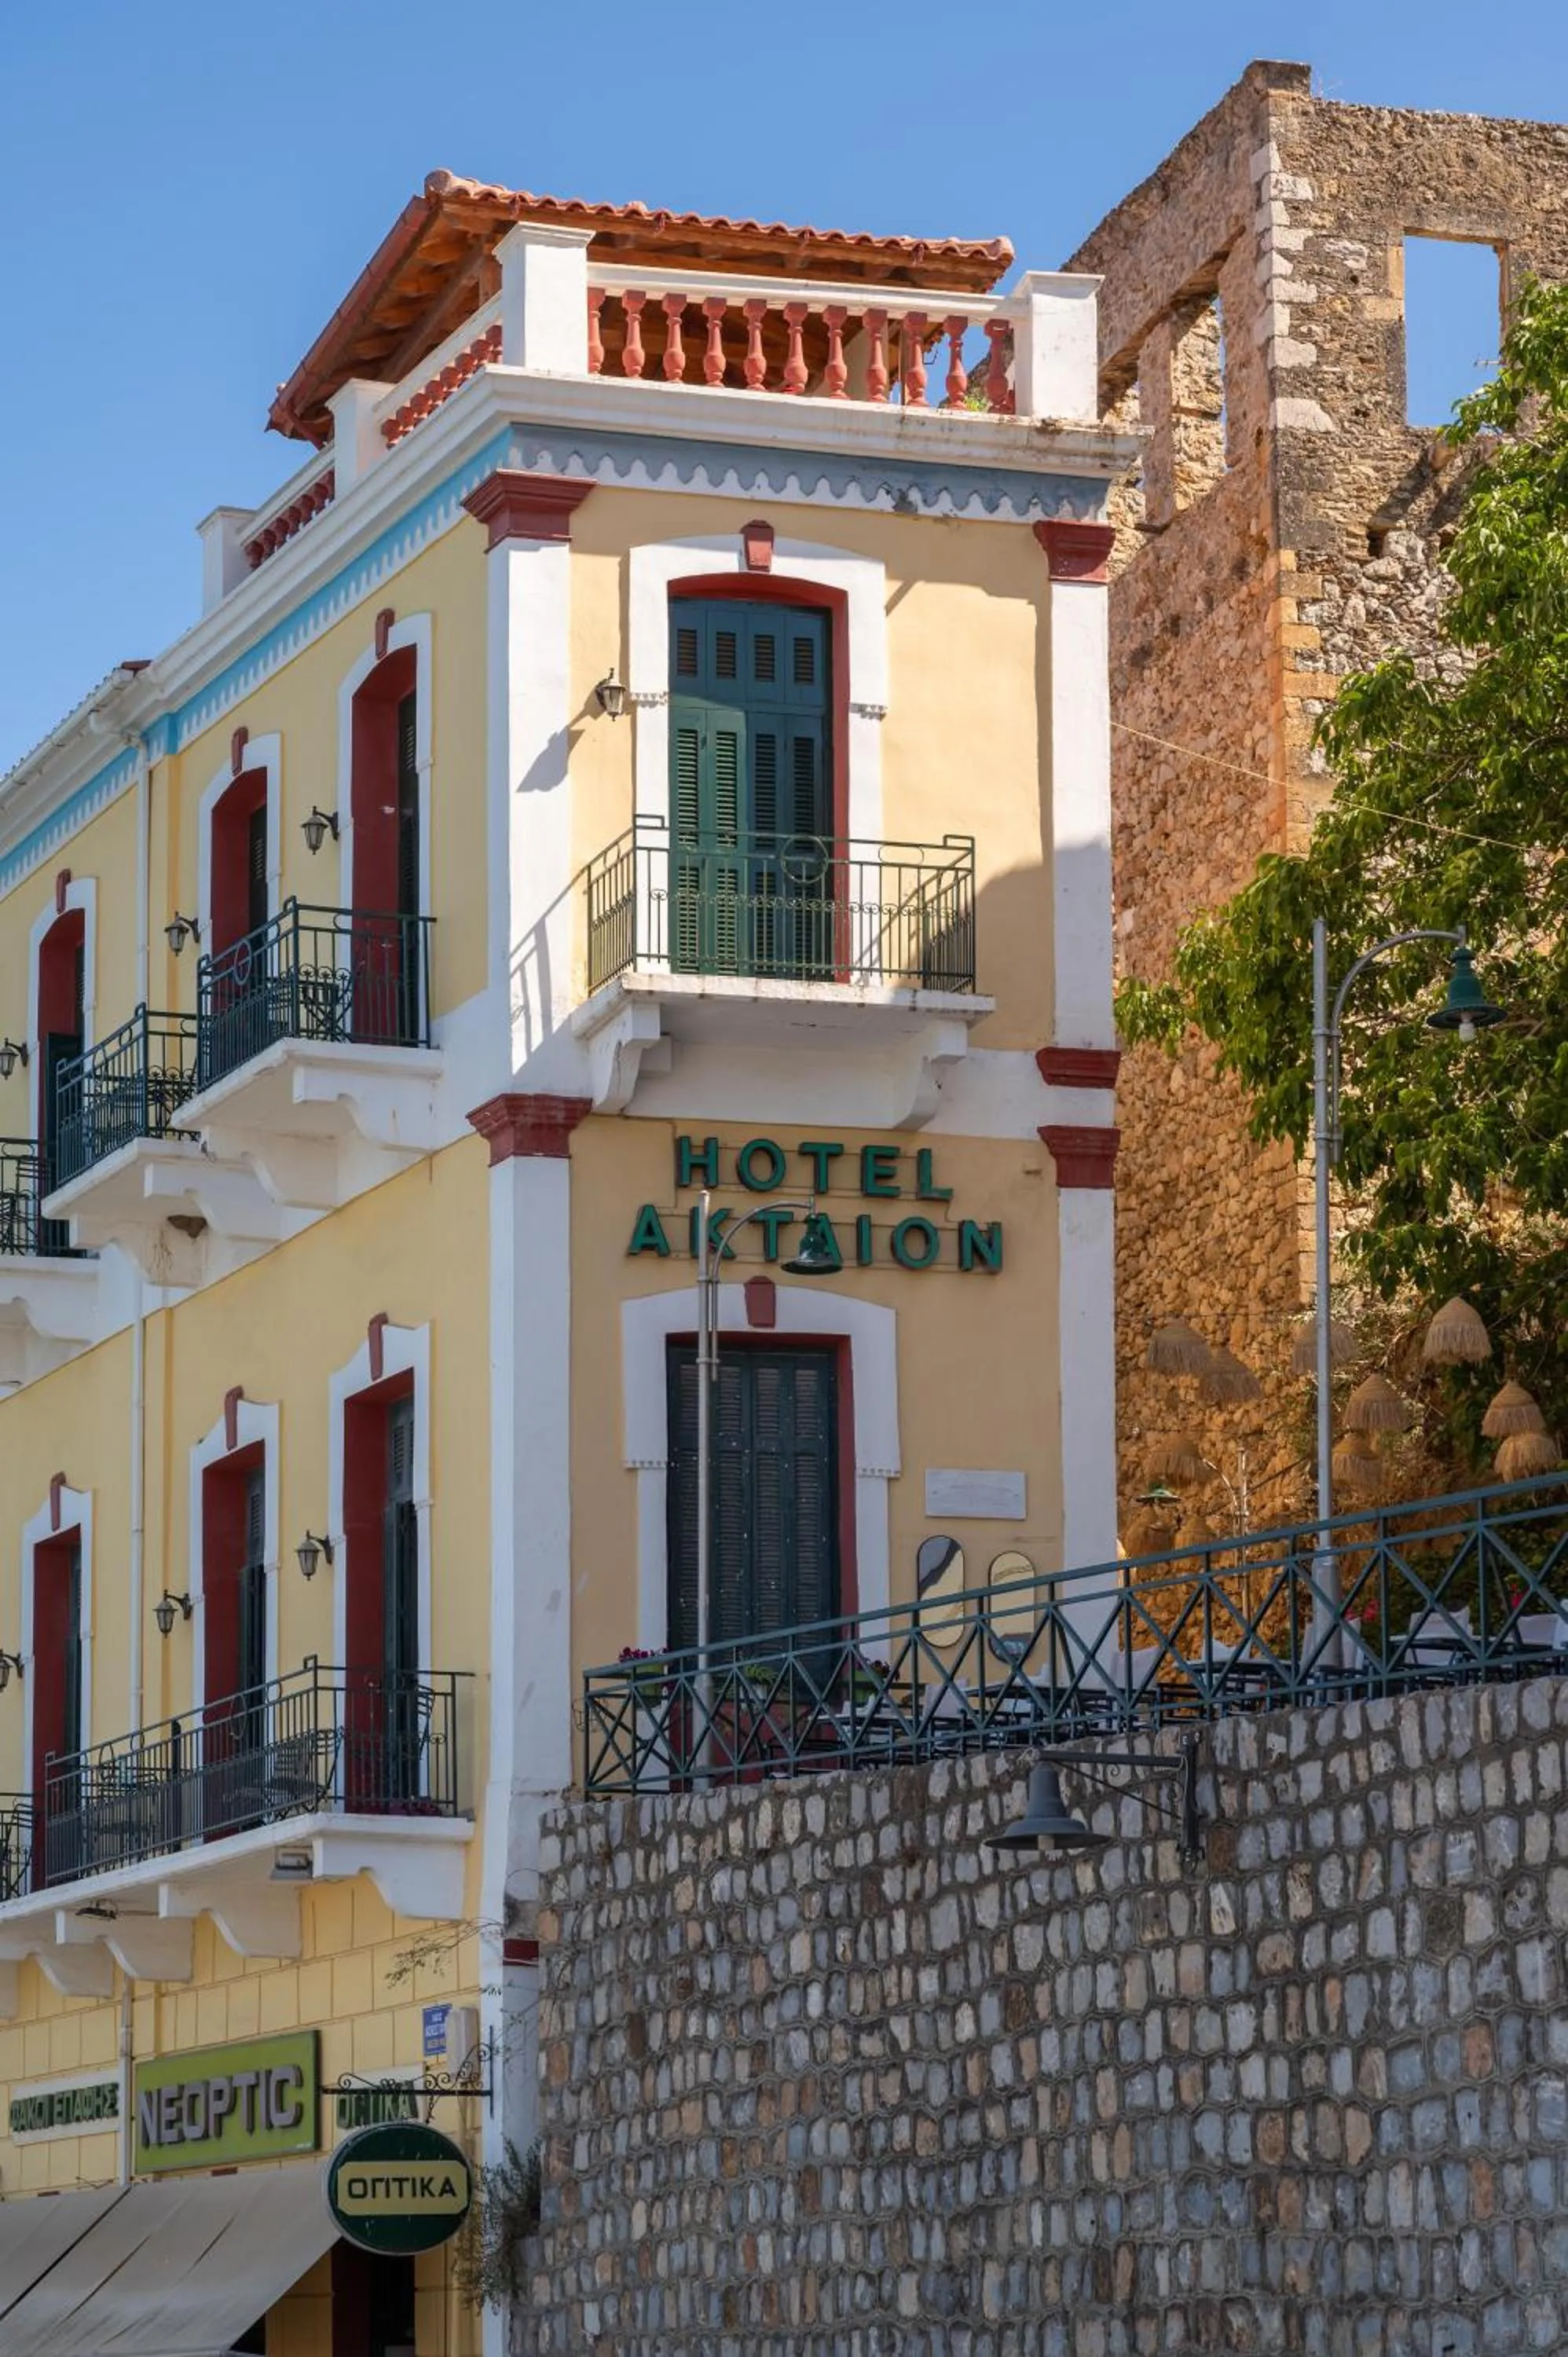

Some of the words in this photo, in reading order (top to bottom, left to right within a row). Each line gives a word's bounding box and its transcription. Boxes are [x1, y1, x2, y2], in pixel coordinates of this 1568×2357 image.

[676, 1136, 954, 1200] HOTEL
[54, 2082, 119, 2124] ΕΠΑΦΗΣ
[139, 2065, 303, 2150] NEOPTIC
[348, 2177, 456, 2198] ΟΠΤΙΚΑ
